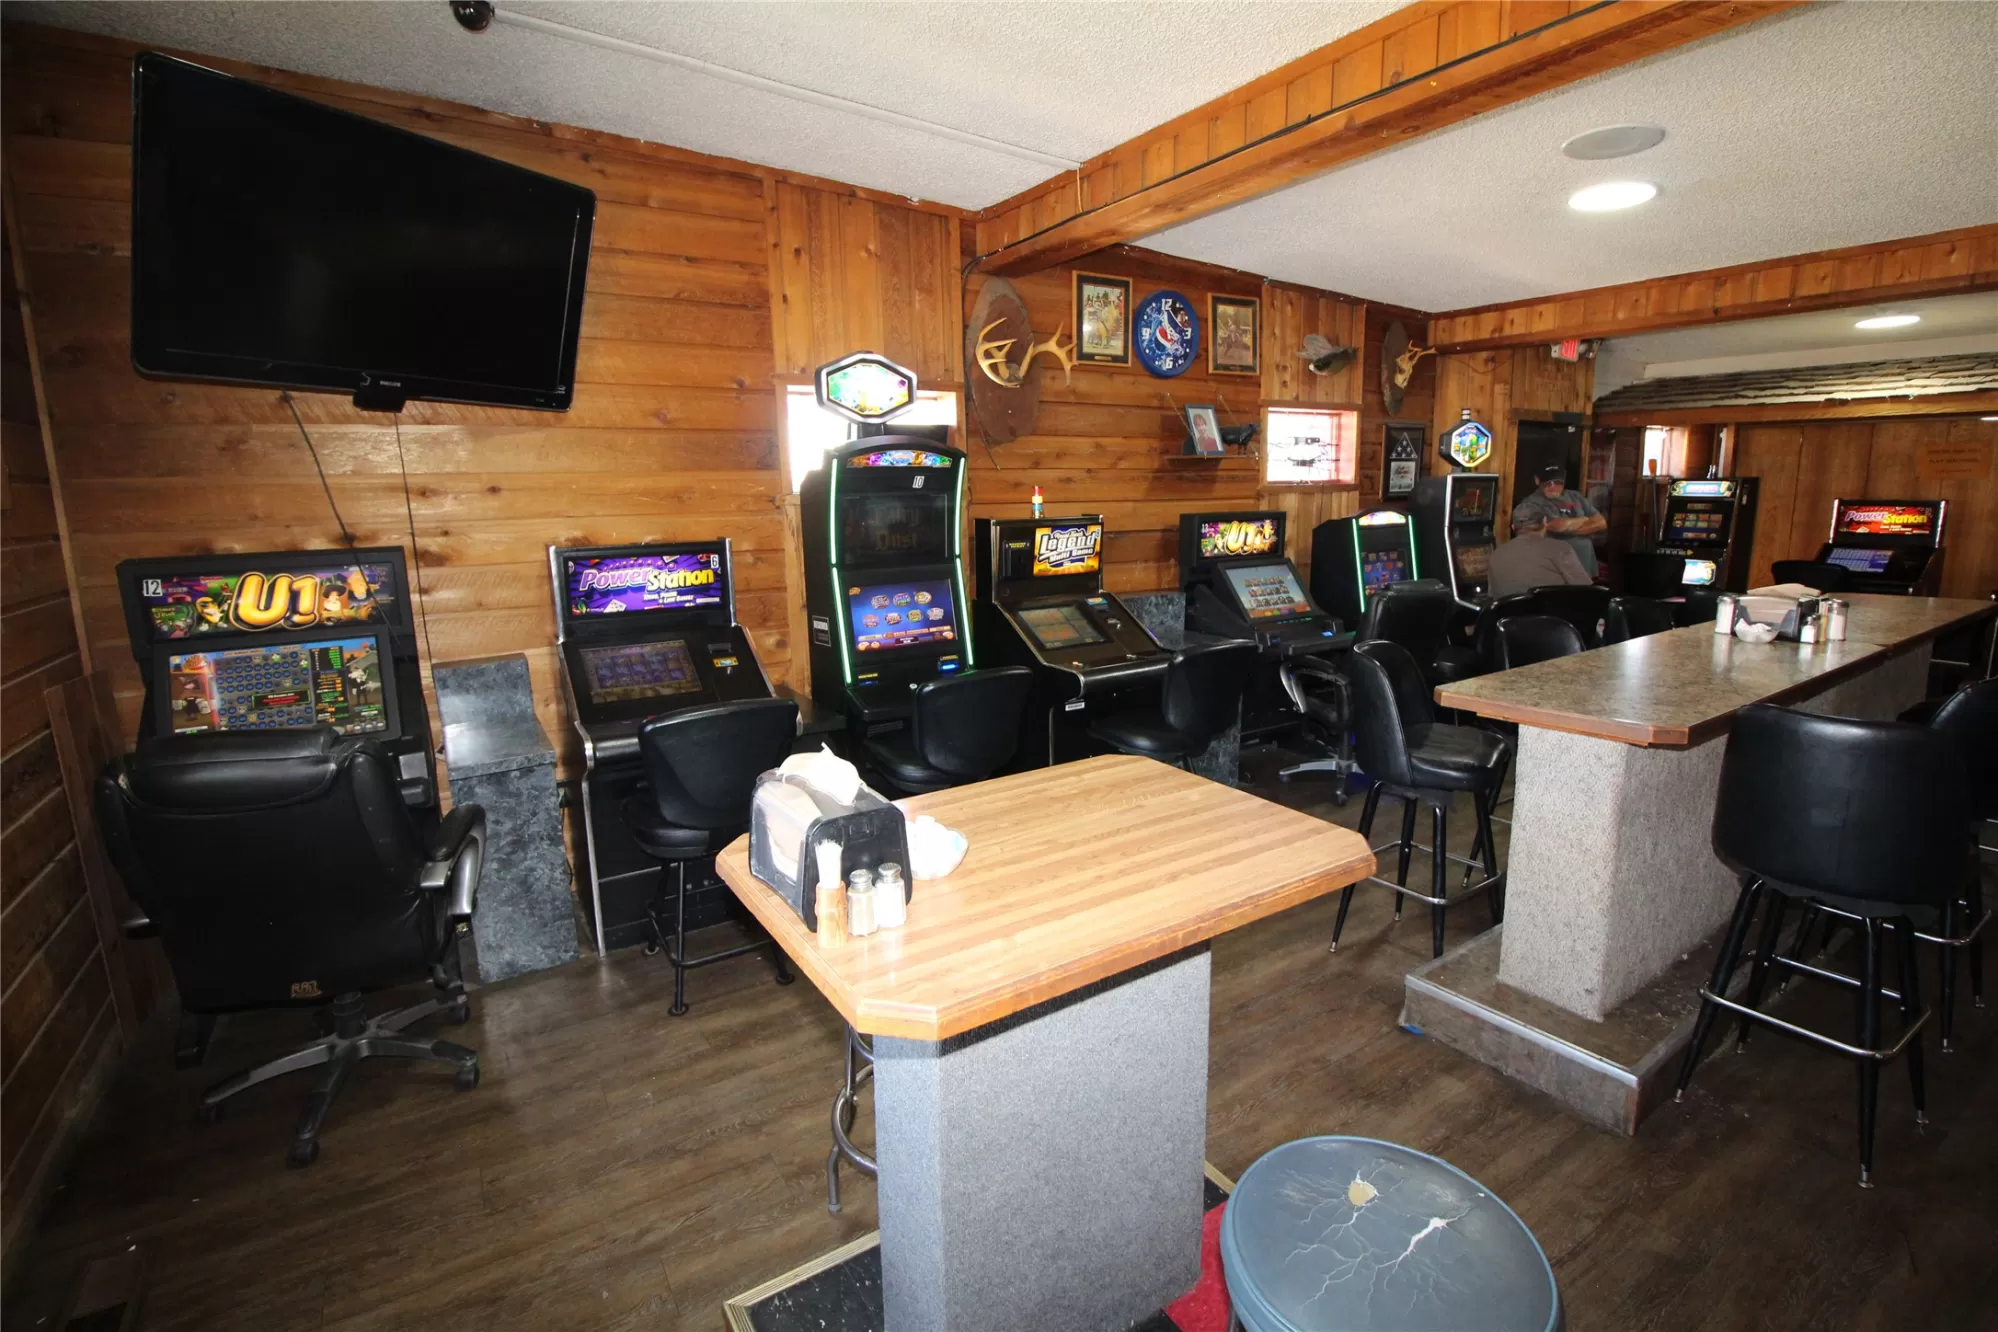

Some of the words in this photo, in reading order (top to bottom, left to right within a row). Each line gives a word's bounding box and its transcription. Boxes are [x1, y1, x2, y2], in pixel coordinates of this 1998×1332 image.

[1161, 298, 1172, 311] 12
[1142, 327, 1151, 339] 9
[1183, 327, 1192, 339] 3
[1165, 357, 1173, 369] 6
[912, 475, 925, 488] 10
[1039, 531, 1096, 554] Legend
[712, 556, 718, 567] 6
[144, 581, 161, 595] 12
[233, 572, 319, 629] U1
